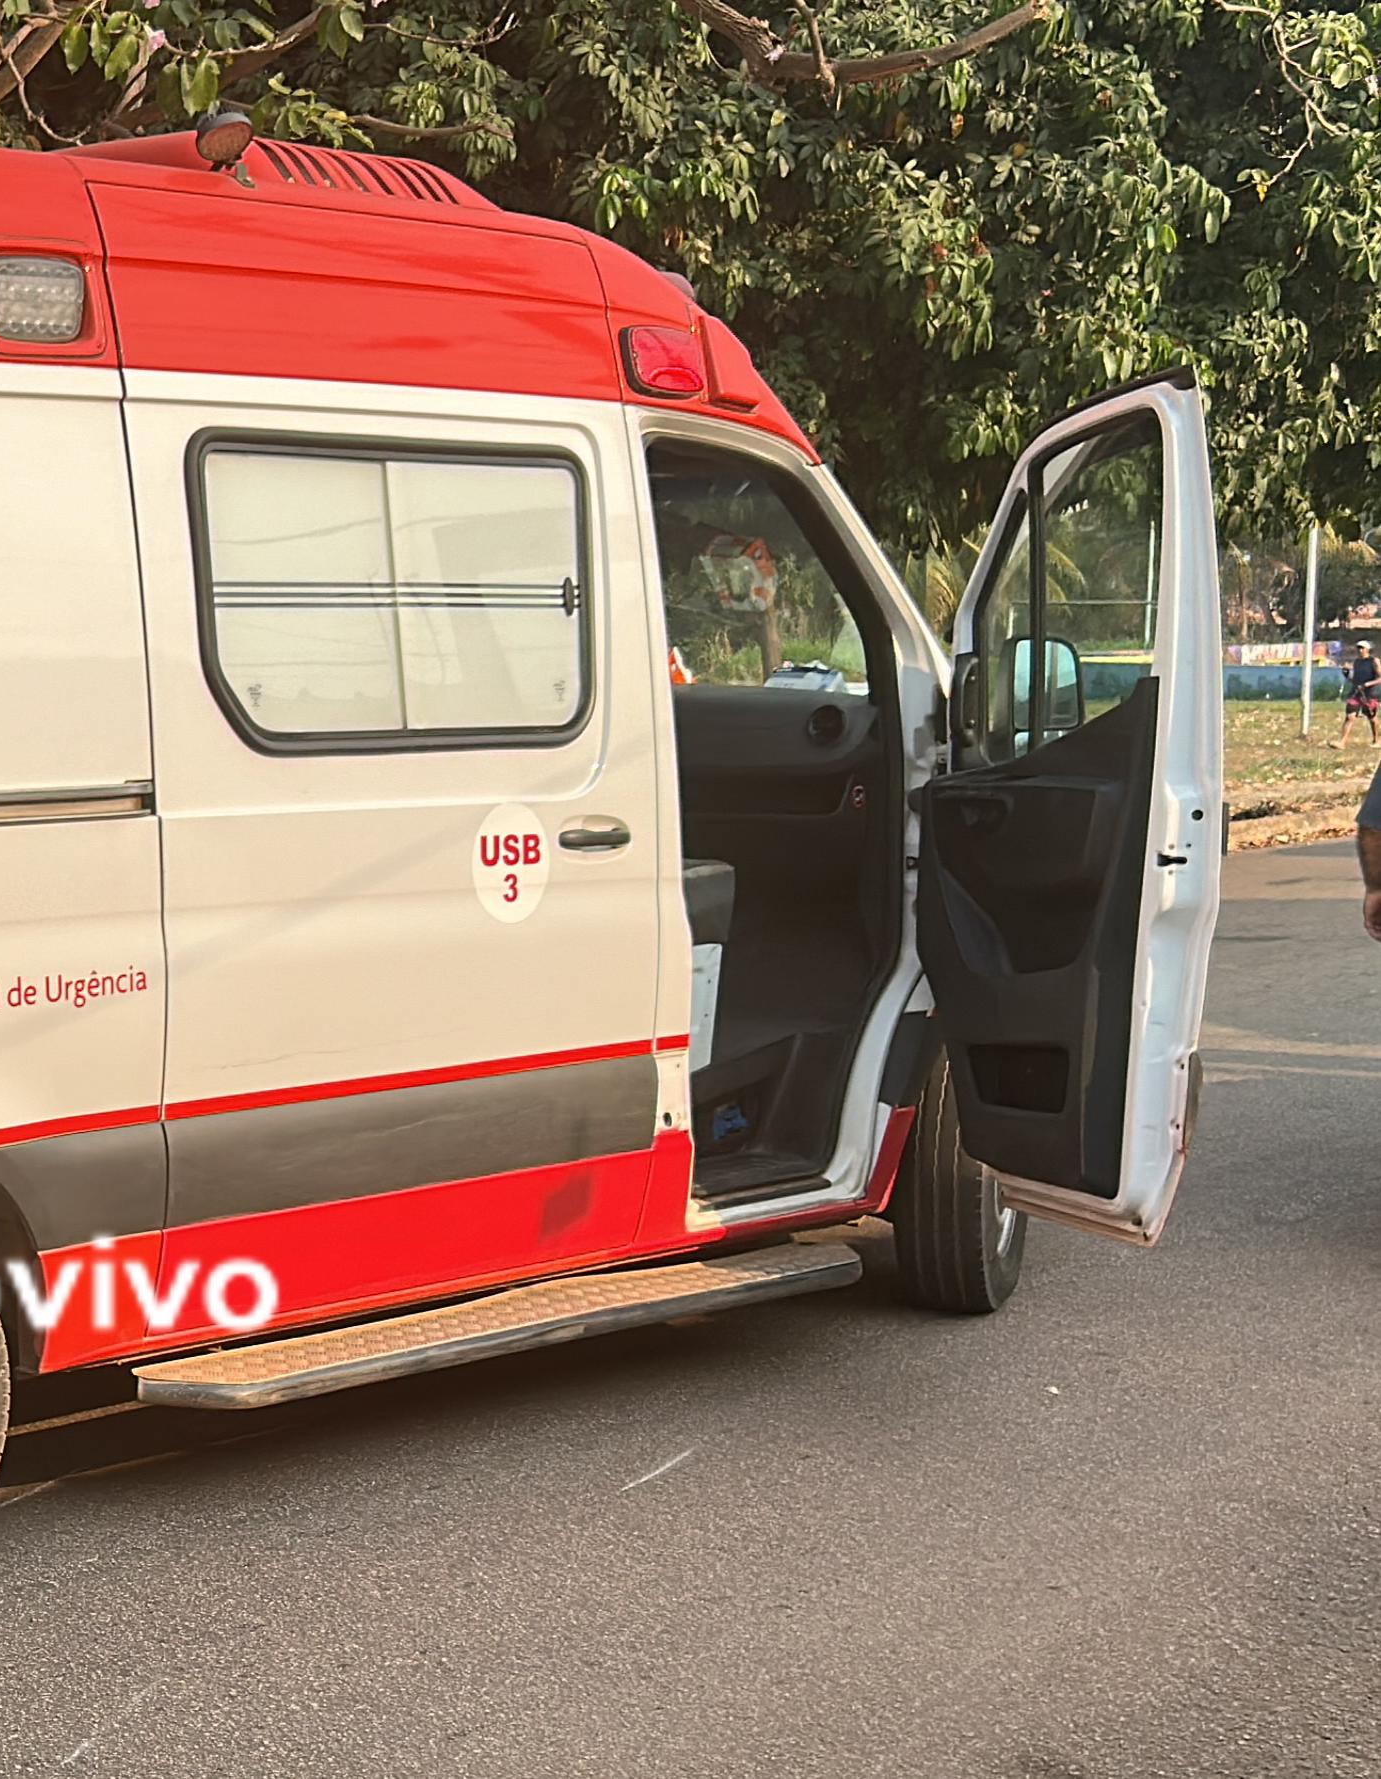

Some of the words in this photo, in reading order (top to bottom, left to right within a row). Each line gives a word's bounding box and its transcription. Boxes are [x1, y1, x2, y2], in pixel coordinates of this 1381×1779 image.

[479, 833, 542, 867] USB
[502, 873, 519, 903] 3
[6, 977, 38, 1008] de
[44, 966, 148, 1009] Urgência
